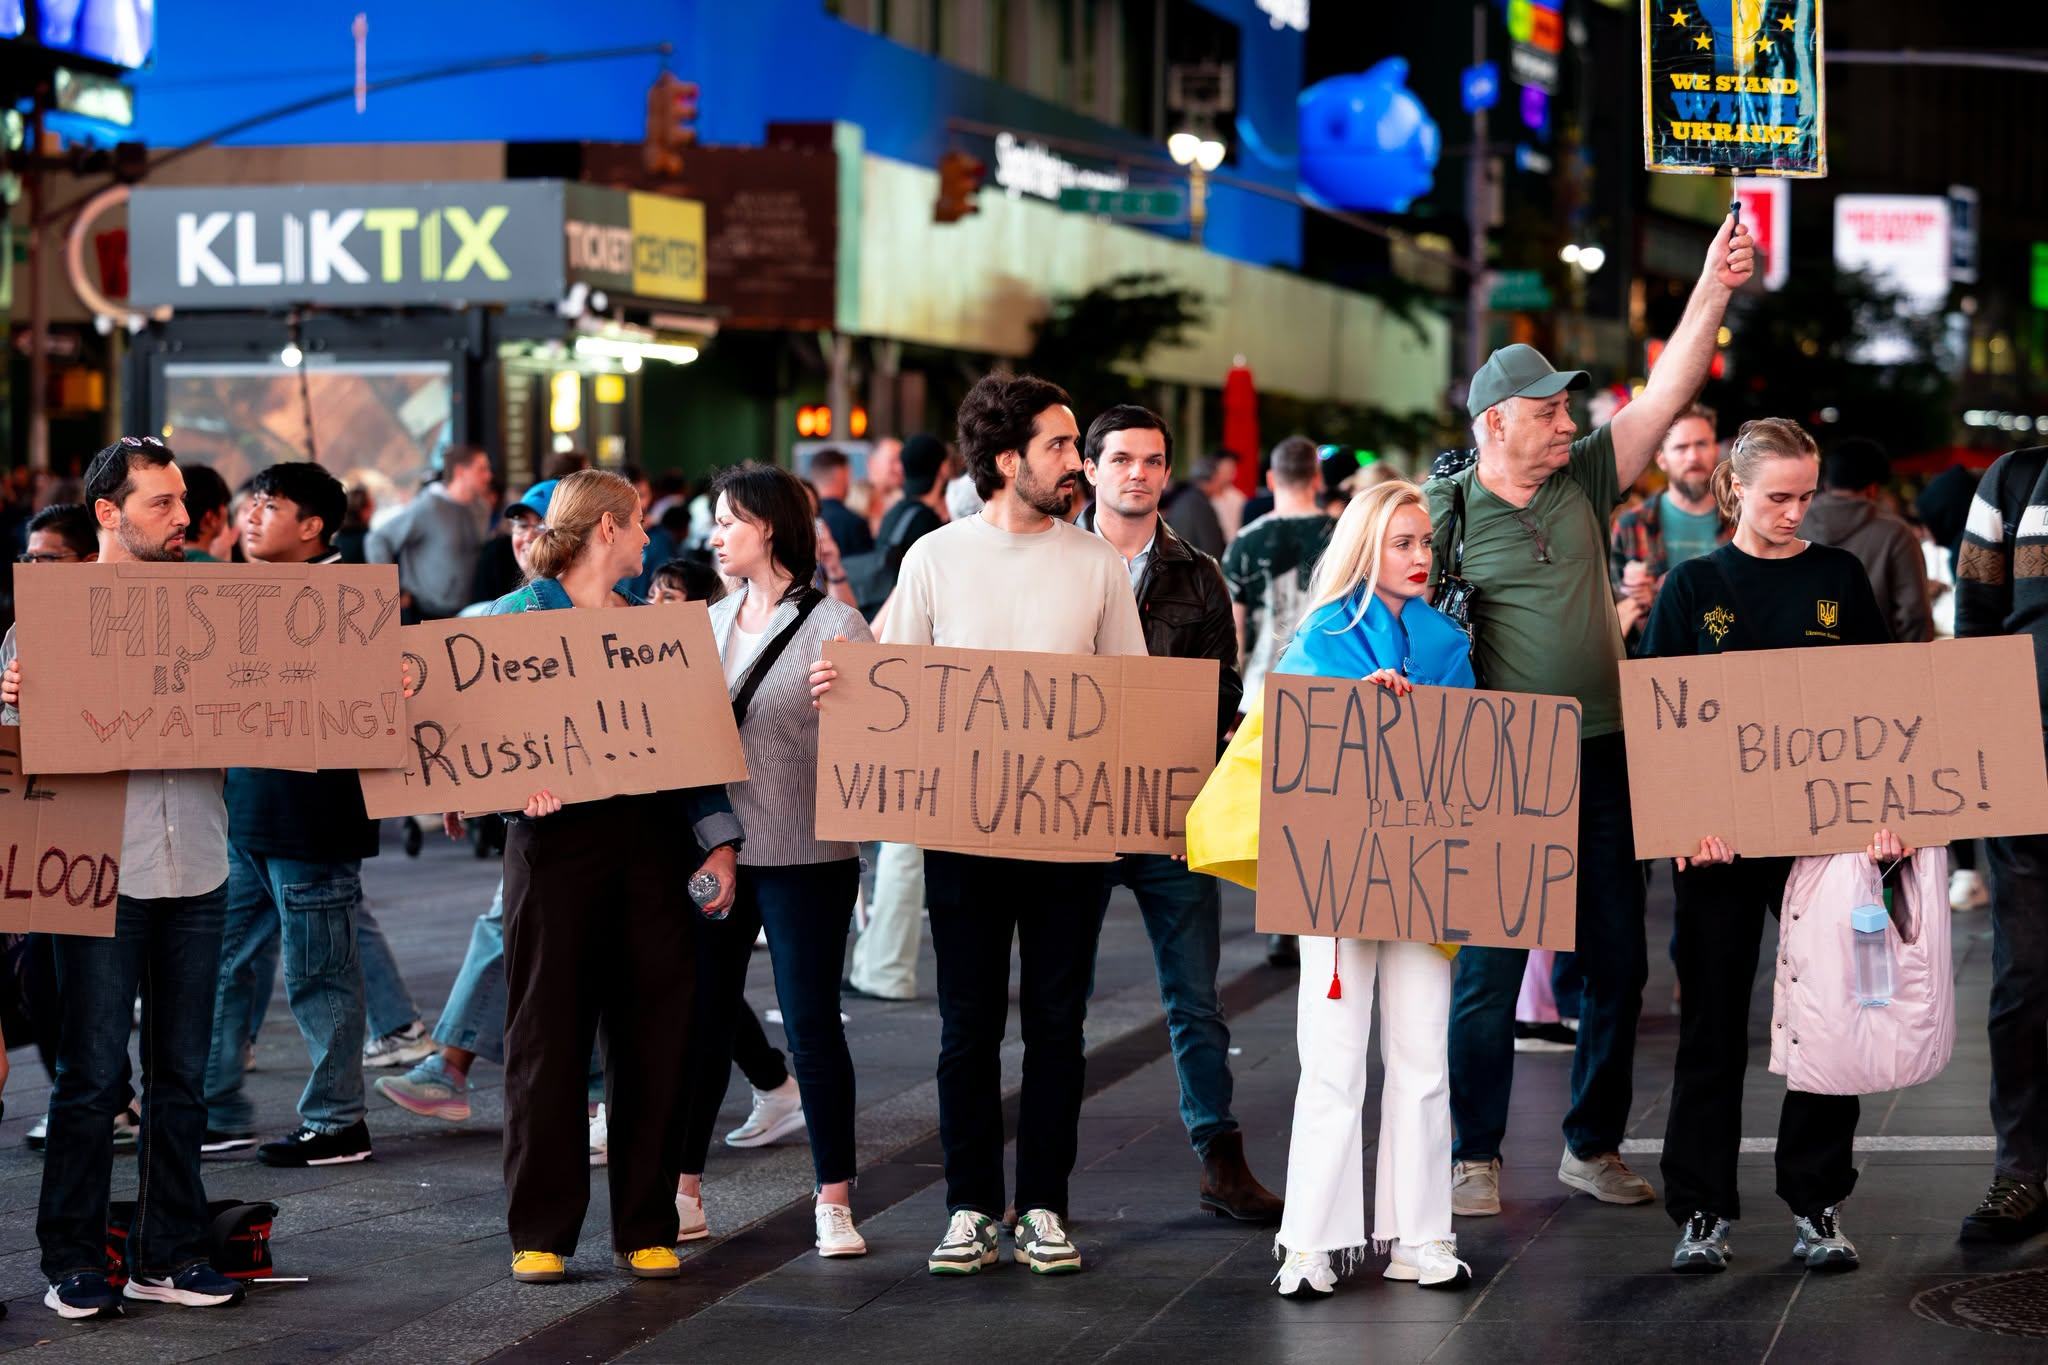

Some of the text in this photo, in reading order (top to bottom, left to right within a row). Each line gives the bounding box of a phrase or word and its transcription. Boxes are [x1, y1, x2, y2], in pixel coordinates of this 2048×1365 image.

[1670, 73, 1799, 95] WE STAND
[1670, 92, 1801, 124] WITH
[1670, 121, 1801, 145] UKRAINE
[177, 205, 512, 287] KLIKTIX
[89, 583, 400, 662] HISTORY
[445, 633, 576, 693] Diesel
[601, 633, 690, 669] FROM
[867, 657, 1107, 742] STAND
[81, 691, 398, 744] WATCHING!
[1272, 684, 1582, 818] DEAR WORLD
[833, 749, 1201, 840] WITH UKRAINE
[1369, 799, 1474, 829] PLEASE
[1806, 749, 1992, 836] DEALS!
[0, 842, 119, 909] LOOD
[1282, 825, 1576, 946] WAKE UP
